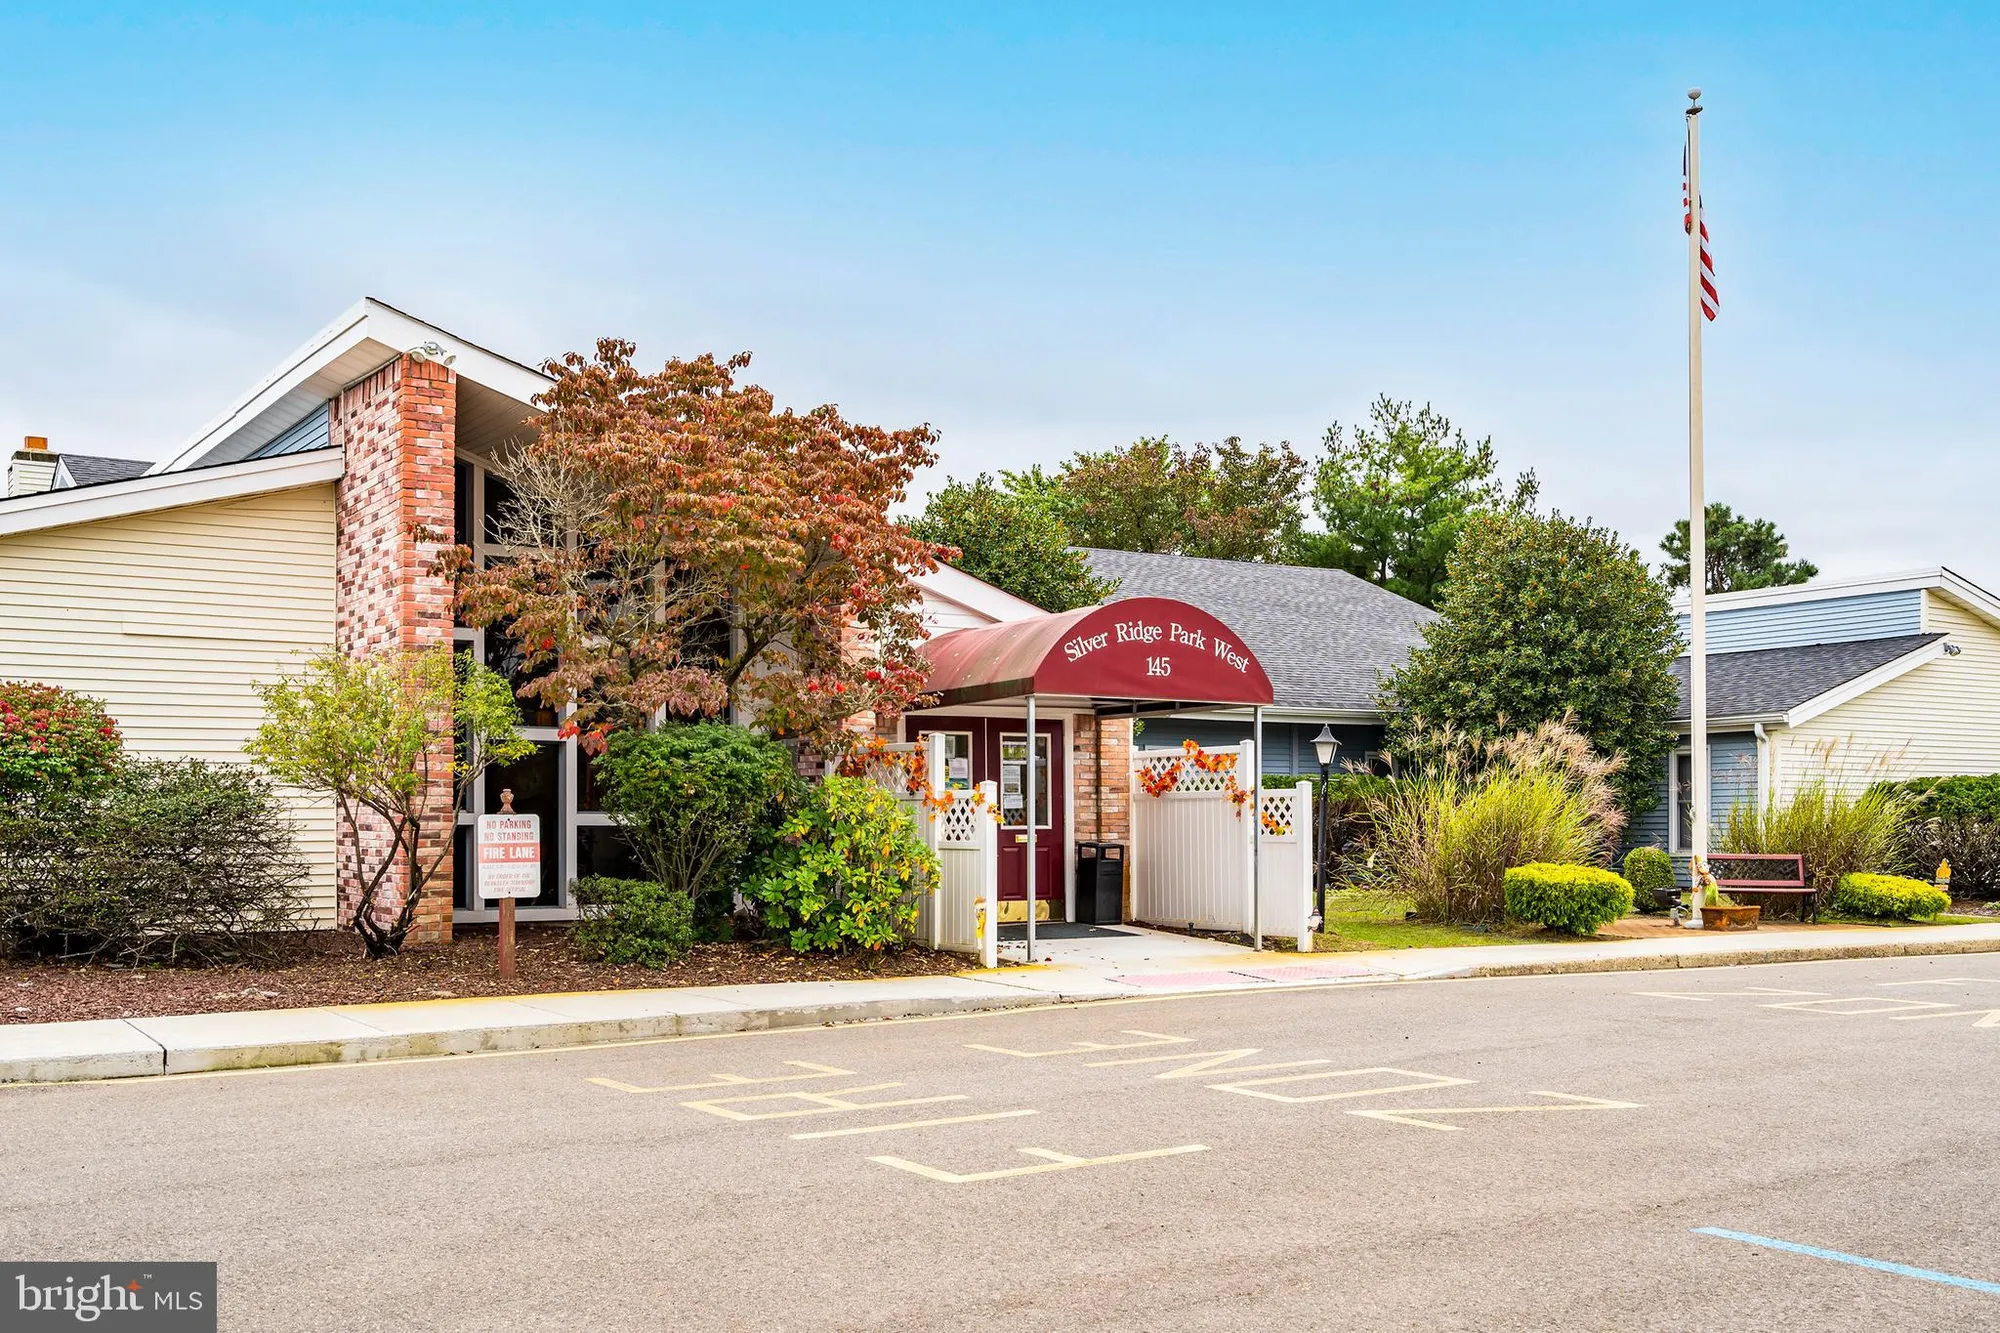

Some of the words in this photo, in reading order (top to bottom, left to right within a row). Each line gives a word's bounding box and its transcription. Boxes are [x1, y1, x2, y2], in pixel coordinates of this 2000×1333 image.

[1064, 632, 1109, 663] Silver
[1114, 620, 1163, 644] Ridge
[1169, 622, 1206, 651] Park
[1213, 637, 1250, 673] West
[1146, 656, 1171, 677] 145
[486, 820, 496, 829] NO
[500, 820, 532, 829] PARKING
[484, 832, 495, 841] NO
[497, 832, 534, 841] STANDING
[483, 847, 505, 860] FIRE
[509, 846, 535, 859] LANE
